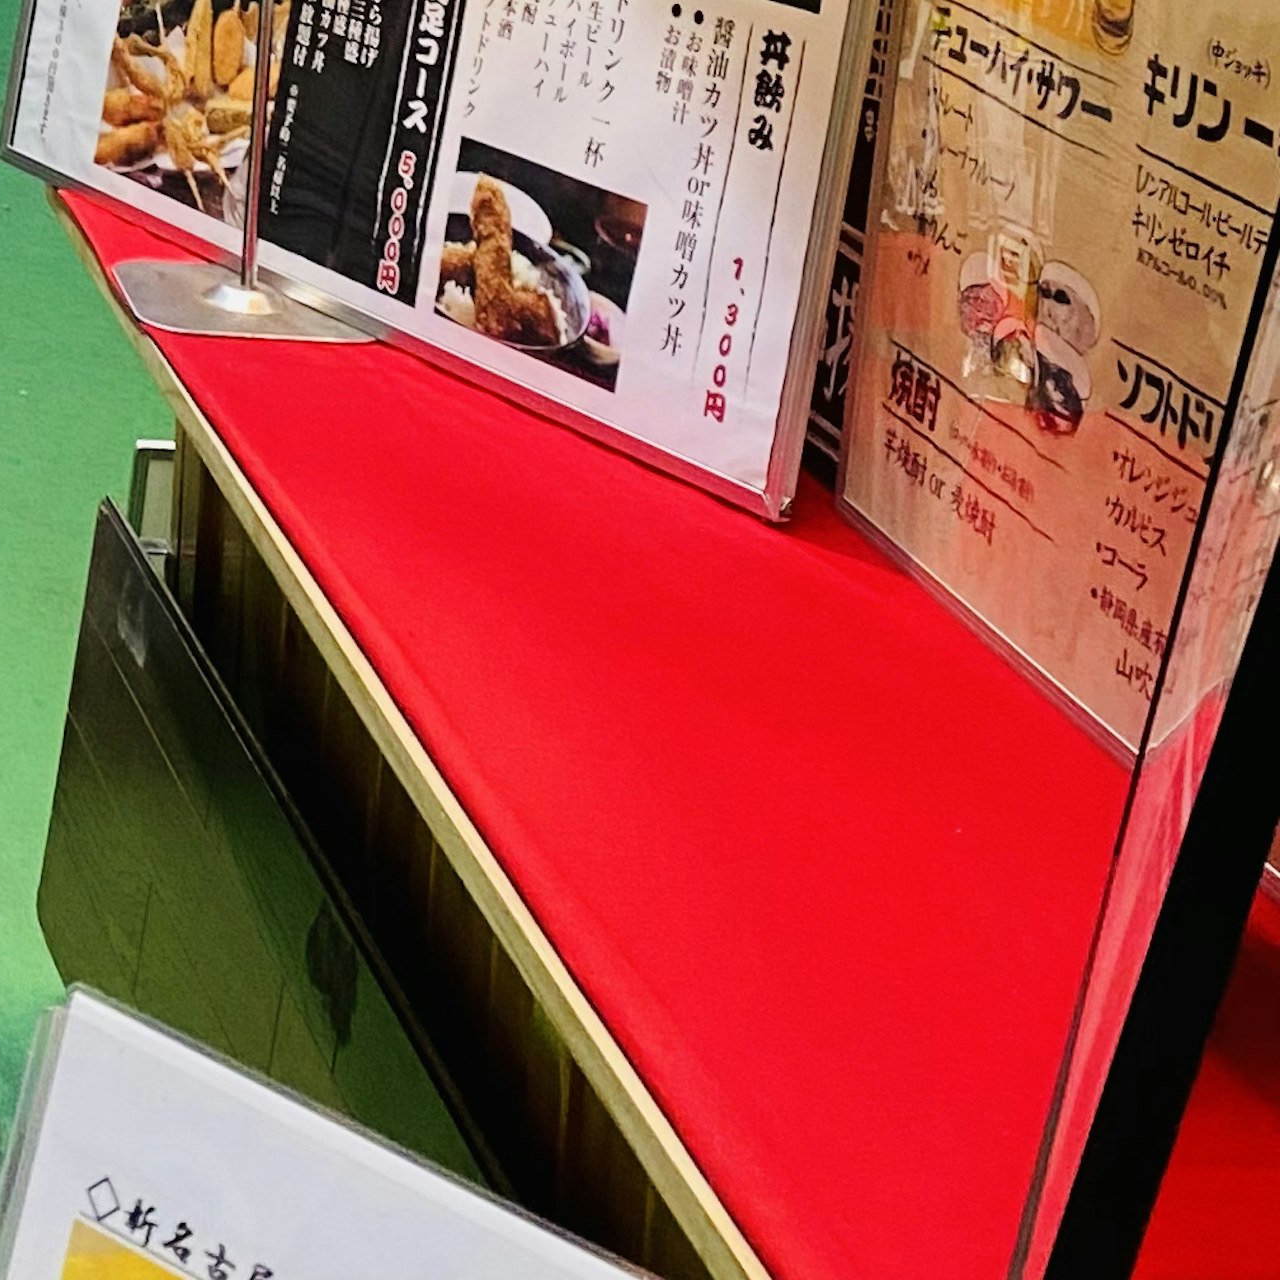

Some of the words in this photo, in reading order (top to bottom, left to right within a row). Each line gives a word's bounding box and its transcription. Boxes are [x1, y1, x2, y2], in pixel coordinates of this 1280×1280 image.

[575, 0, 605, 89] 生ビール
[654, 24, 681, 94] お漬物
[671, 30, 705, 125] お味噌汁
[747, 28, 793, 153] 丼飲み
[661, 16, 737, 358] 醤油カツ丼or味噌カツ丼
[888, 348, 942, 432] 焼酎
[1100, 543, 1149, 592] コーラ
